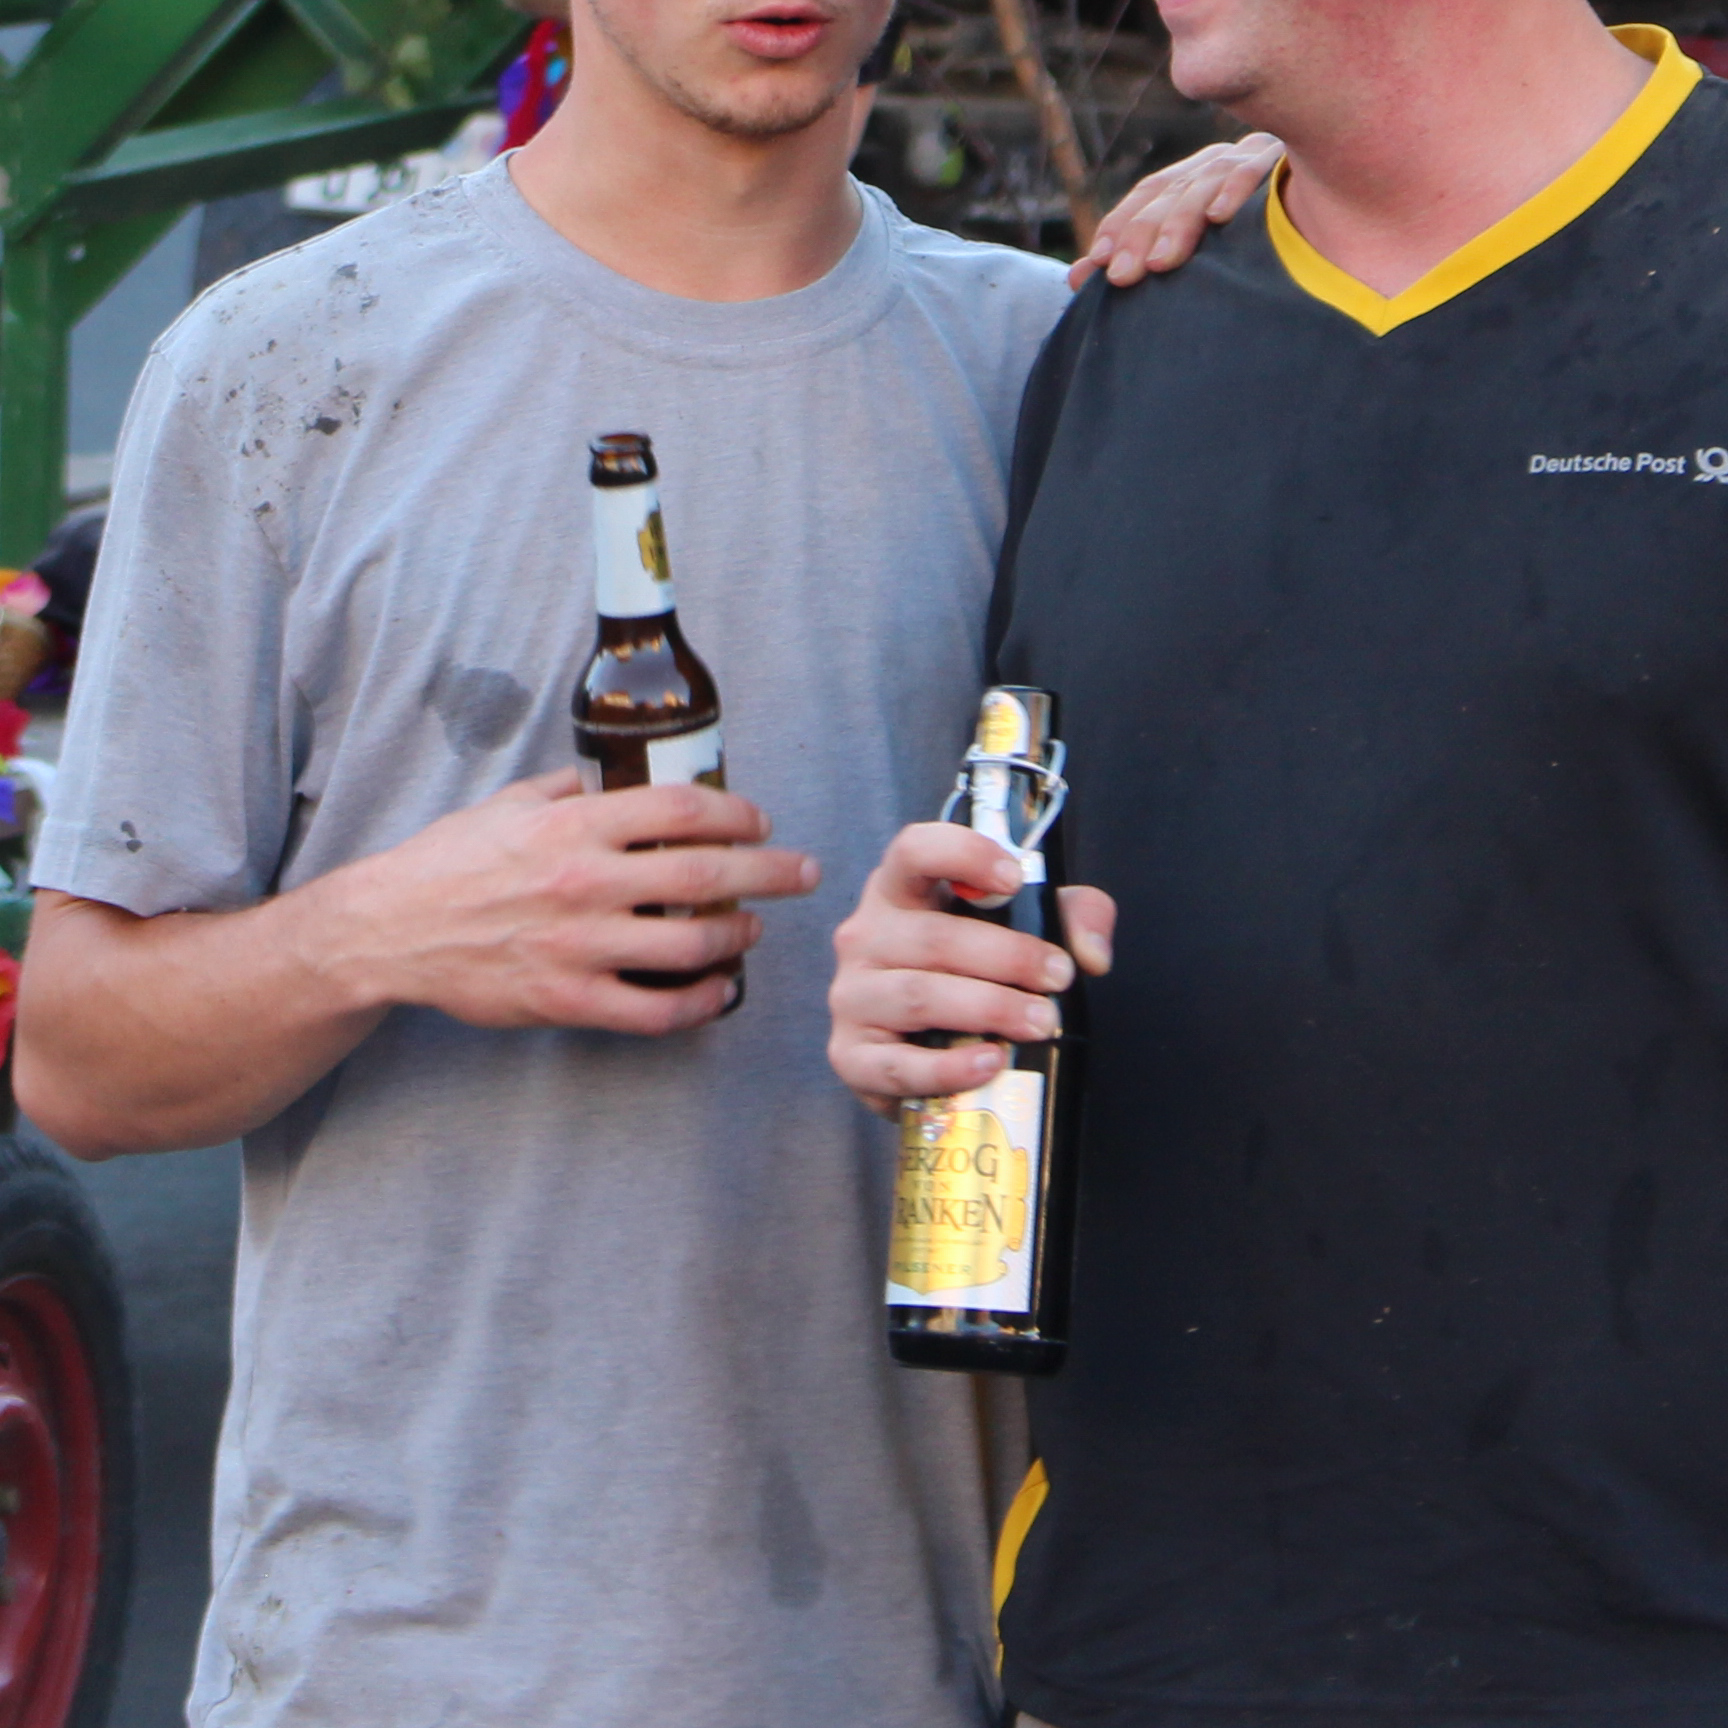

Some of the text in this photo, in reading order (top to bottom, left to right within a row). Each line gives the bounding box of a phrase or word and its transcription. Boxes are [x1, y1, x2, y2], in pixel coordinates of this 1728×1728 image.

[1528, 451, 1687, 475] Deutsche Post
[895, 1192, 1007, 1234] RANKEN
